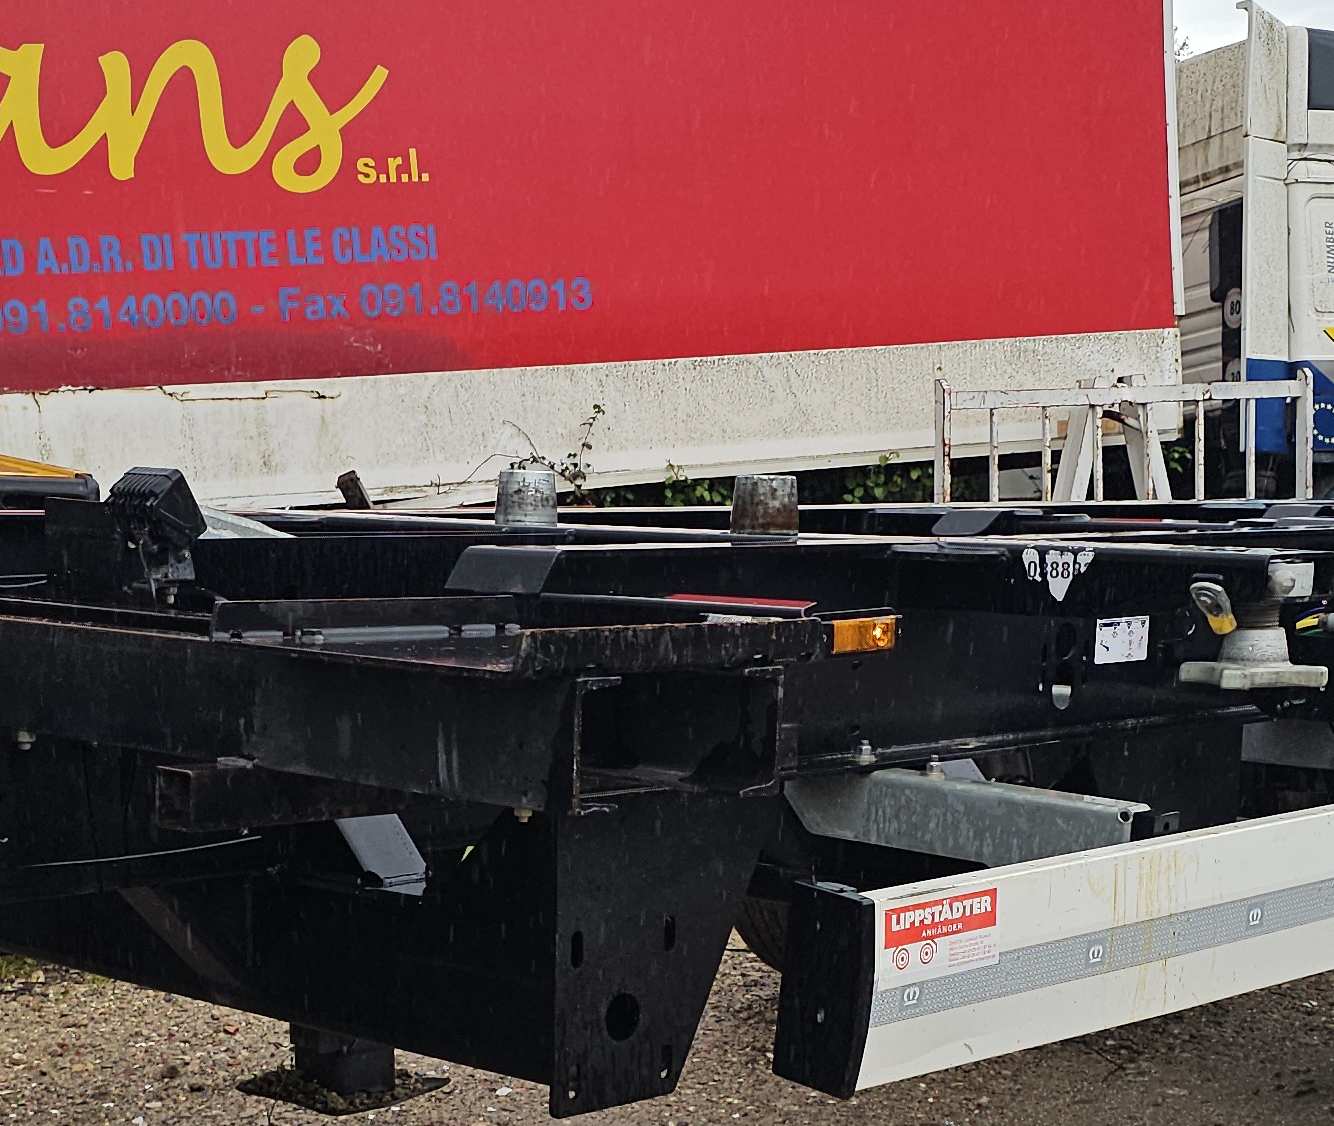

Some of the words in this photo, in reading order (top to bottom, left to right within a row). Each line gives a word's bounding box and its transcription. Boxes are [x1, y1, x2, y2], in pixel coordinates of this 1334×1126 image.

[356, 148, 430, 184] s.r.l.
[37, 236, 133, 275] A.D.R.
[140, 233, 174, 271] DI
[182, 230, 279, 269] TUTTE
[286, 229, 324, 266] LE
[331, 224, 438, 264] CLASSI
[277, 286, 349, 321] Fax
[359, 276, 593, 319] 091.8140913
[1229, 300, 1241, 316] 80
[891, 896, 992, 932] LIPPSTÄDTER
[921, 922, 963, 938] ANHÄNGER
